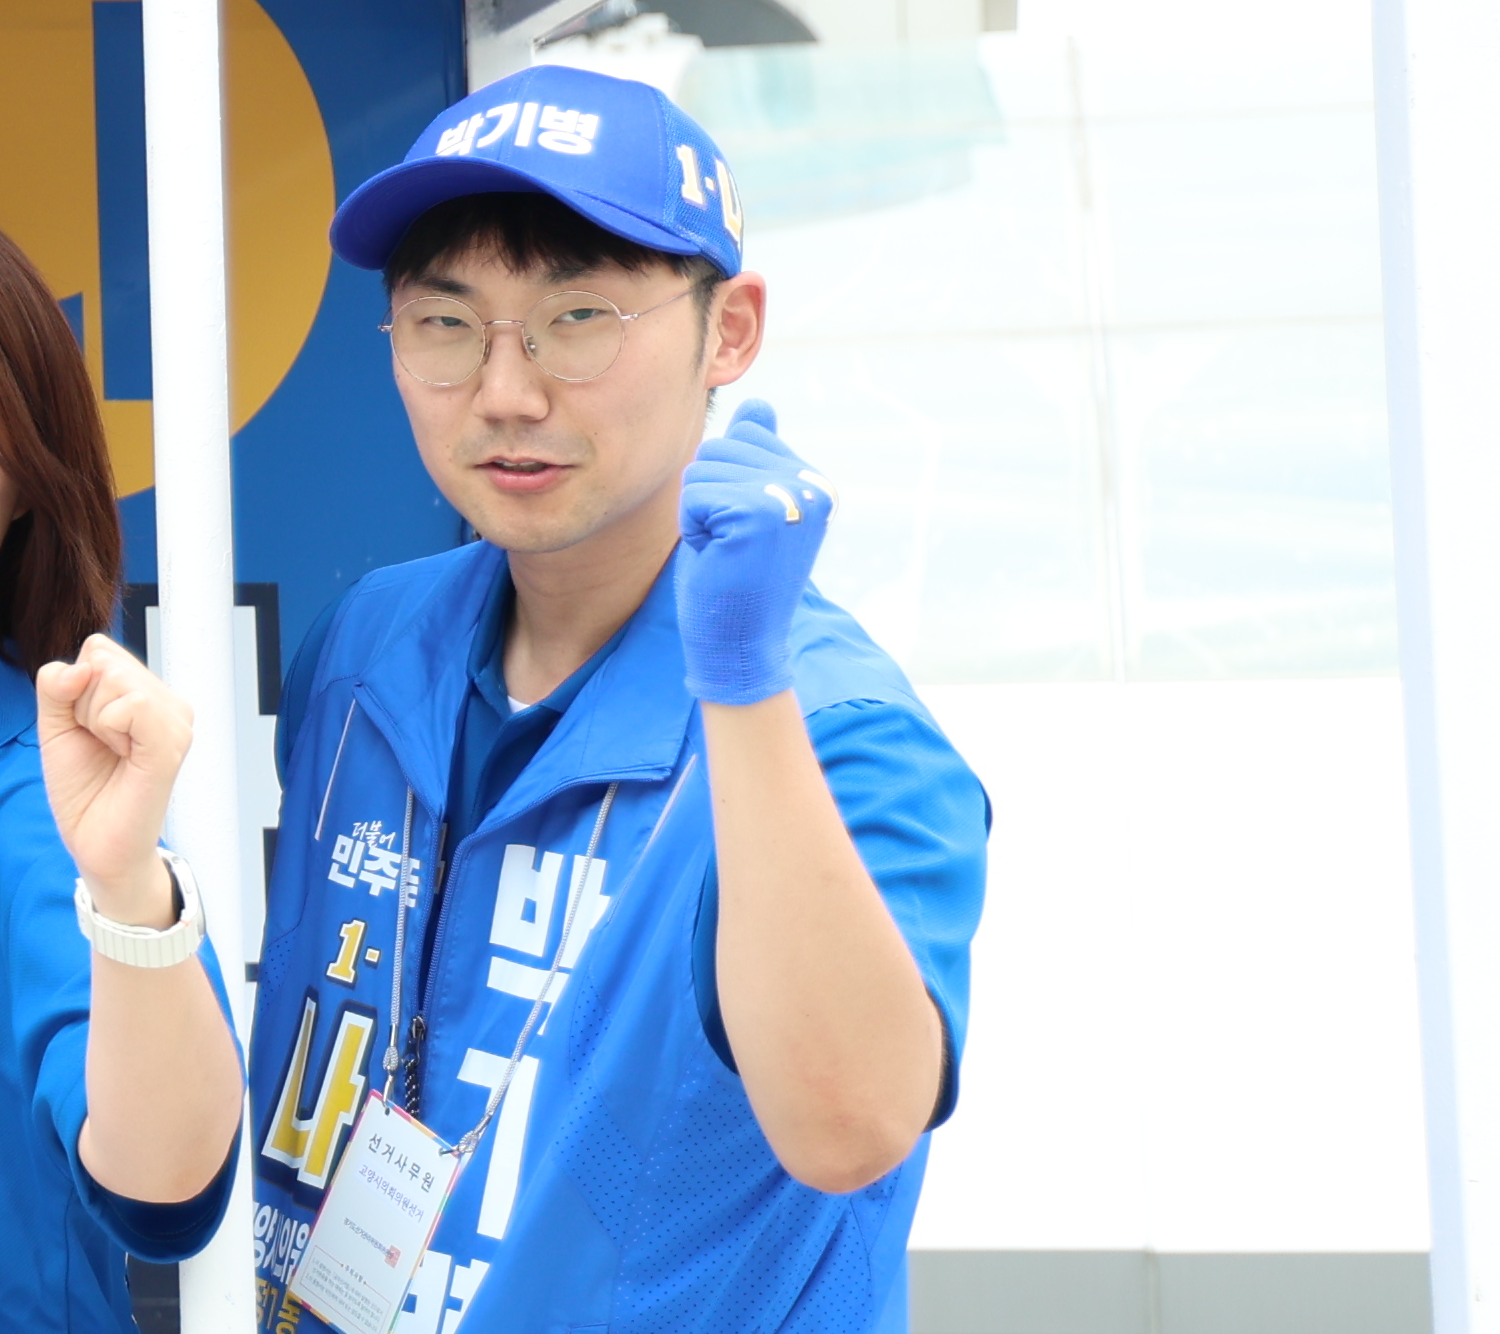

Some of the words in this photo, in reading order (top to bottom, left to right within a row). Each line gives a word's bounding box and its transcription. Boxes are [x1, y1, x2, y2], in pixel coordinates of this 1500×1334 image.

[435, 101, 600, 157] 박기병
[352, 820, 397, 850] 더불어
[260, 995, 375, 1192] 나
[366, 1132, 436, 1194] 선거사무원
[358, 1164, 425, 1223] 고양시의회의원선거
